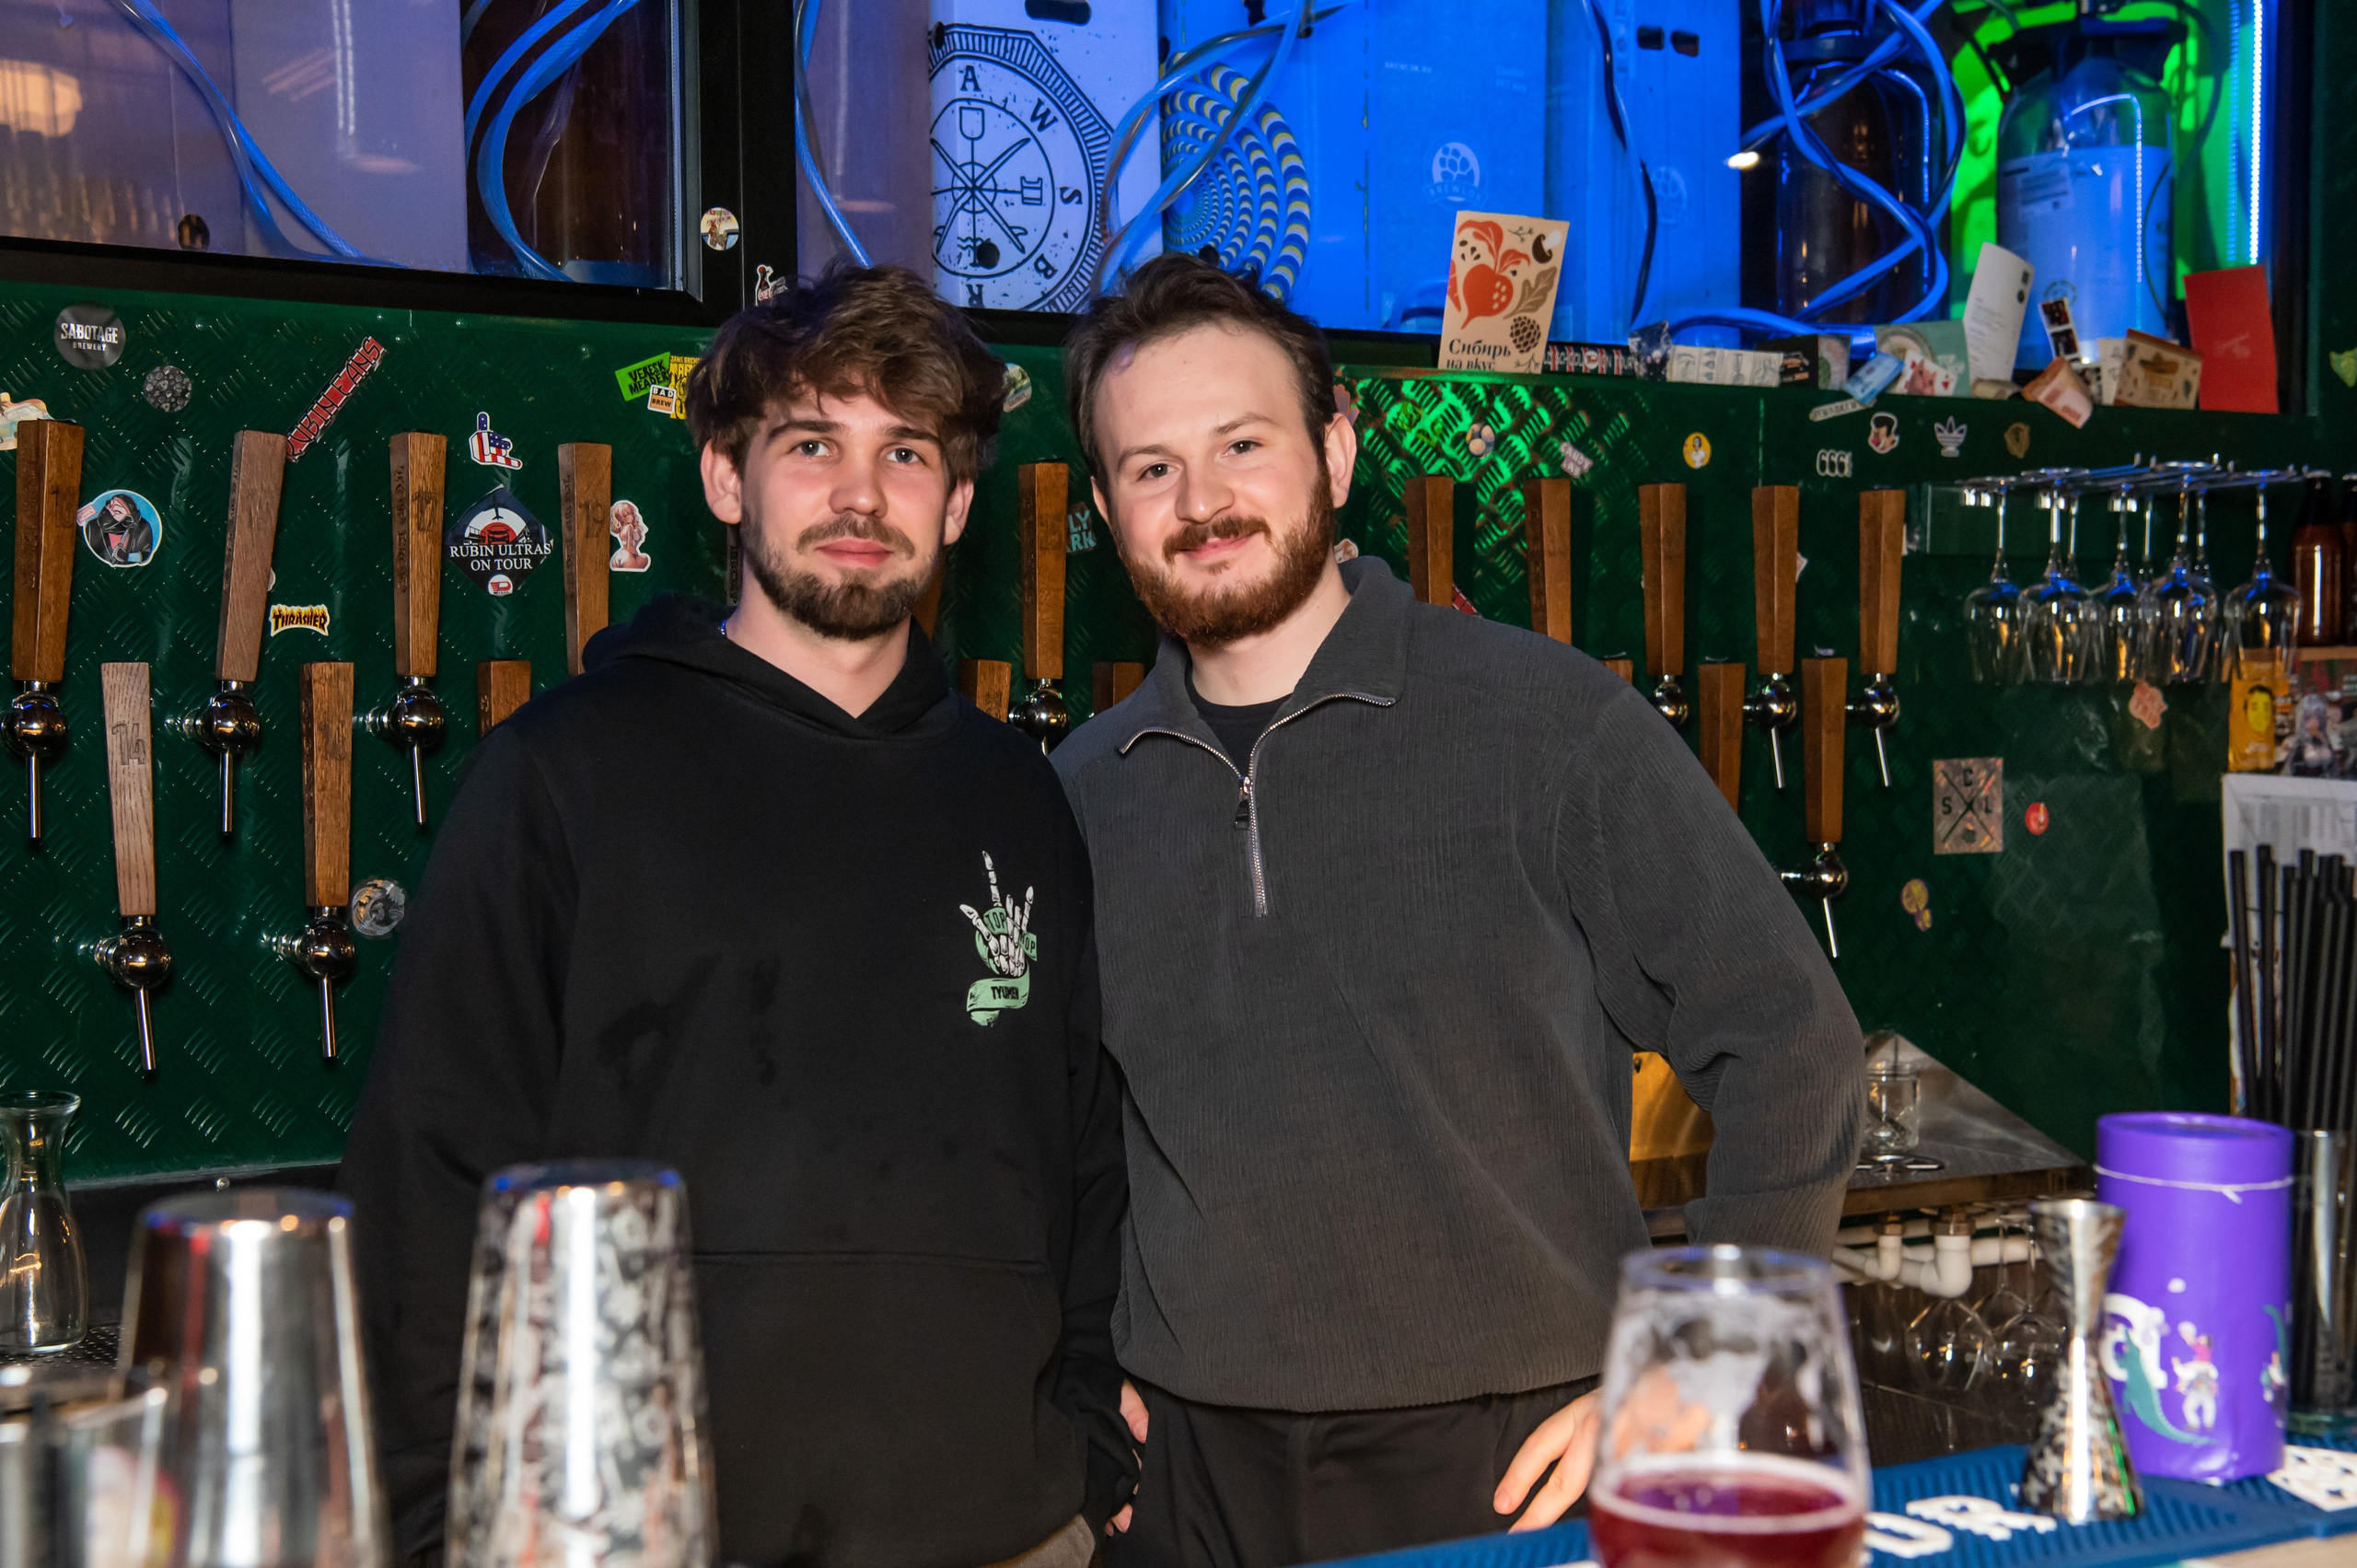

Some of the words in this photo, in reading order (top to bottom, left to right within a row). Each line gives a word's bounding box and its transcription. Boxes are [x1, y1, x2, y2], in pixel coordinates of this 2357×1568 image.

[60, 322, 119, 344] SABOTAGE
[73, 342, 107, 352] BREWERY
[1448, 338, 1512, 360] Сибирь
[628, 359, 666, 382] VERESK
[1446, 358, 1463, 370] на
[1467, 356, 1496, 371] вкус
[653, 387, 675, 398] BAD
[651, 398, 672, 408] BREW
[1068, 509, 1091, 534] LY
[449, 544, 494, 558] RUBIN
[497, 541, 552, 556] ULTRAS
[1067, 528, 1097, 552] RK
[470, 558, 492, 571] ON
[493, 556, 534, 570] TOUR
[271, 607, 328, 633] THRASHER
[110, 722, 146, 765] 14
[984, 912, 1006, 932] TOP
[991, 986, 1019, 1000] TYUMEN
